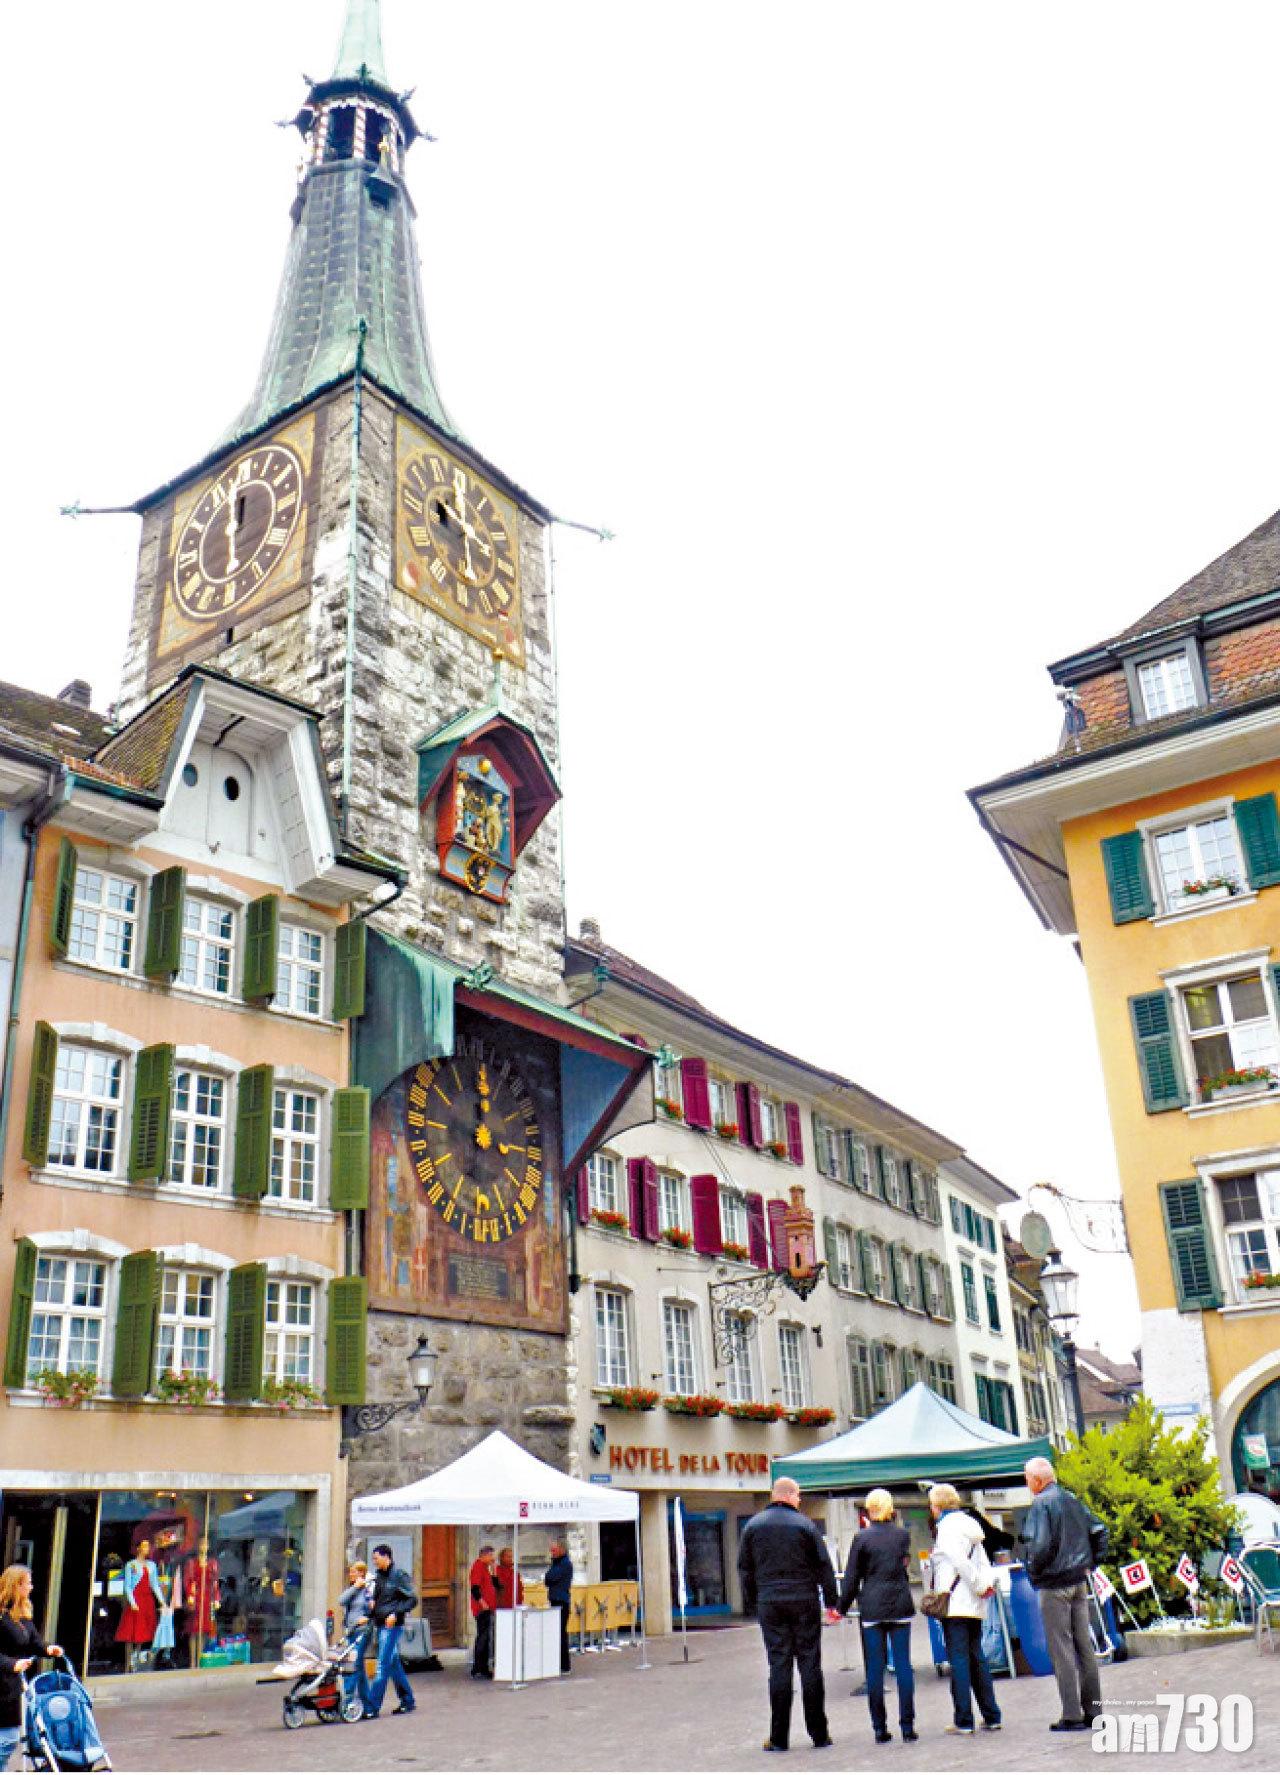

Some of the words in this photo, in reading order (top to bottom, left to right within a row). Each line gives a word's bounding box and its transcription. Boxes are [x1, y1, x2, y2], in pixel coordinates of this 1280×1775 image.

[609, 1445, 675, 1471] HOTEL
[680, 1454, 699, 1472] DE
[701, 1455, 720, 1472] LA
[725, 1452, 769, 1474] TOUR
